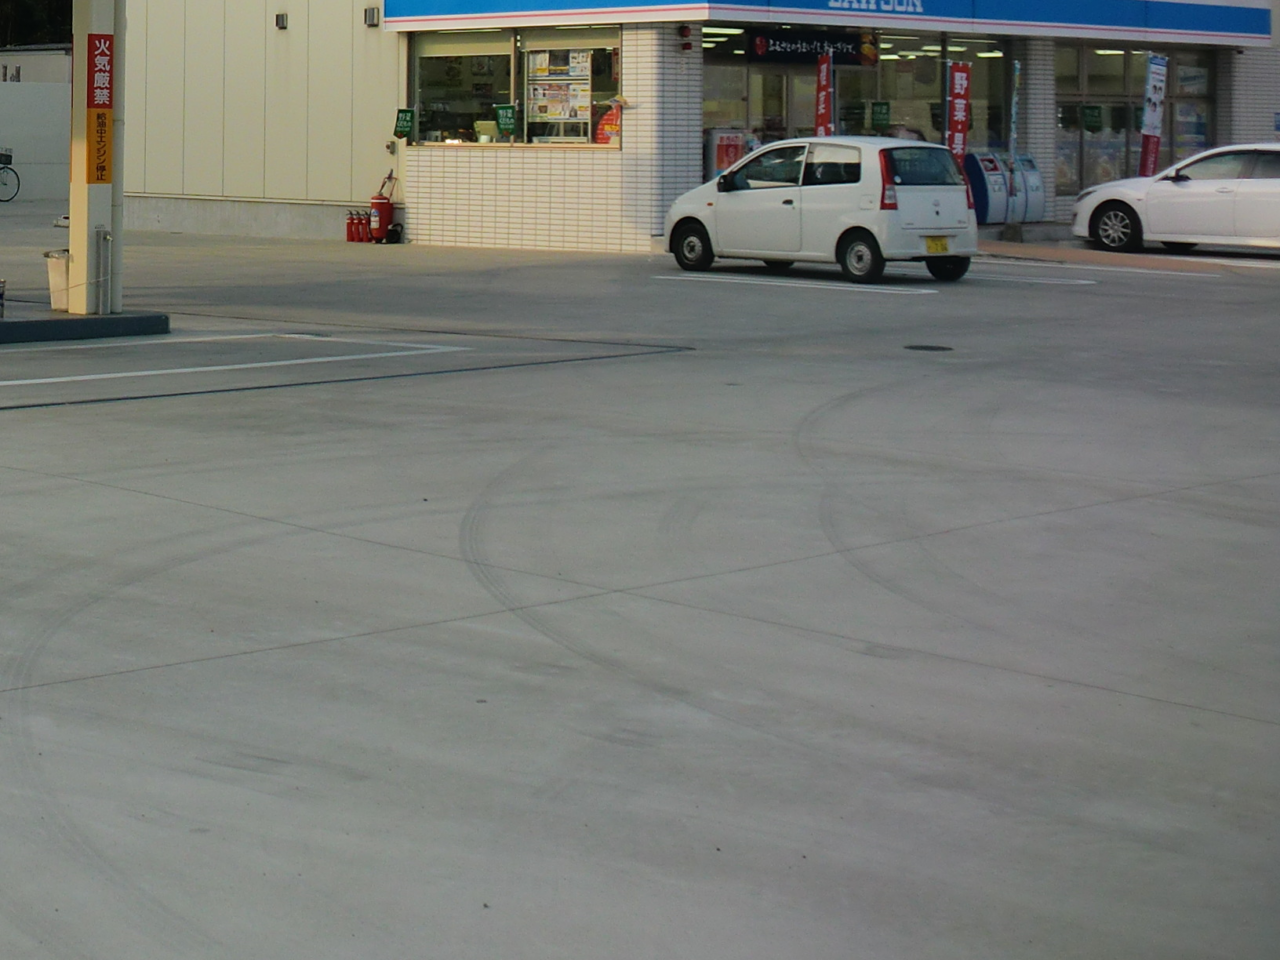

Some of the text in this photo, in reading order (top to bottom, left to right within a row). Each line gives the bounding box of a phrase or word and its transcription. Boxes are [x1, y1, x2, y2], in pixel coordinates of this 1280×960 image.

[94, 39, 110, 105] 火気厳禁
[95, 113, 107, 181] 給油中エンジン停止
